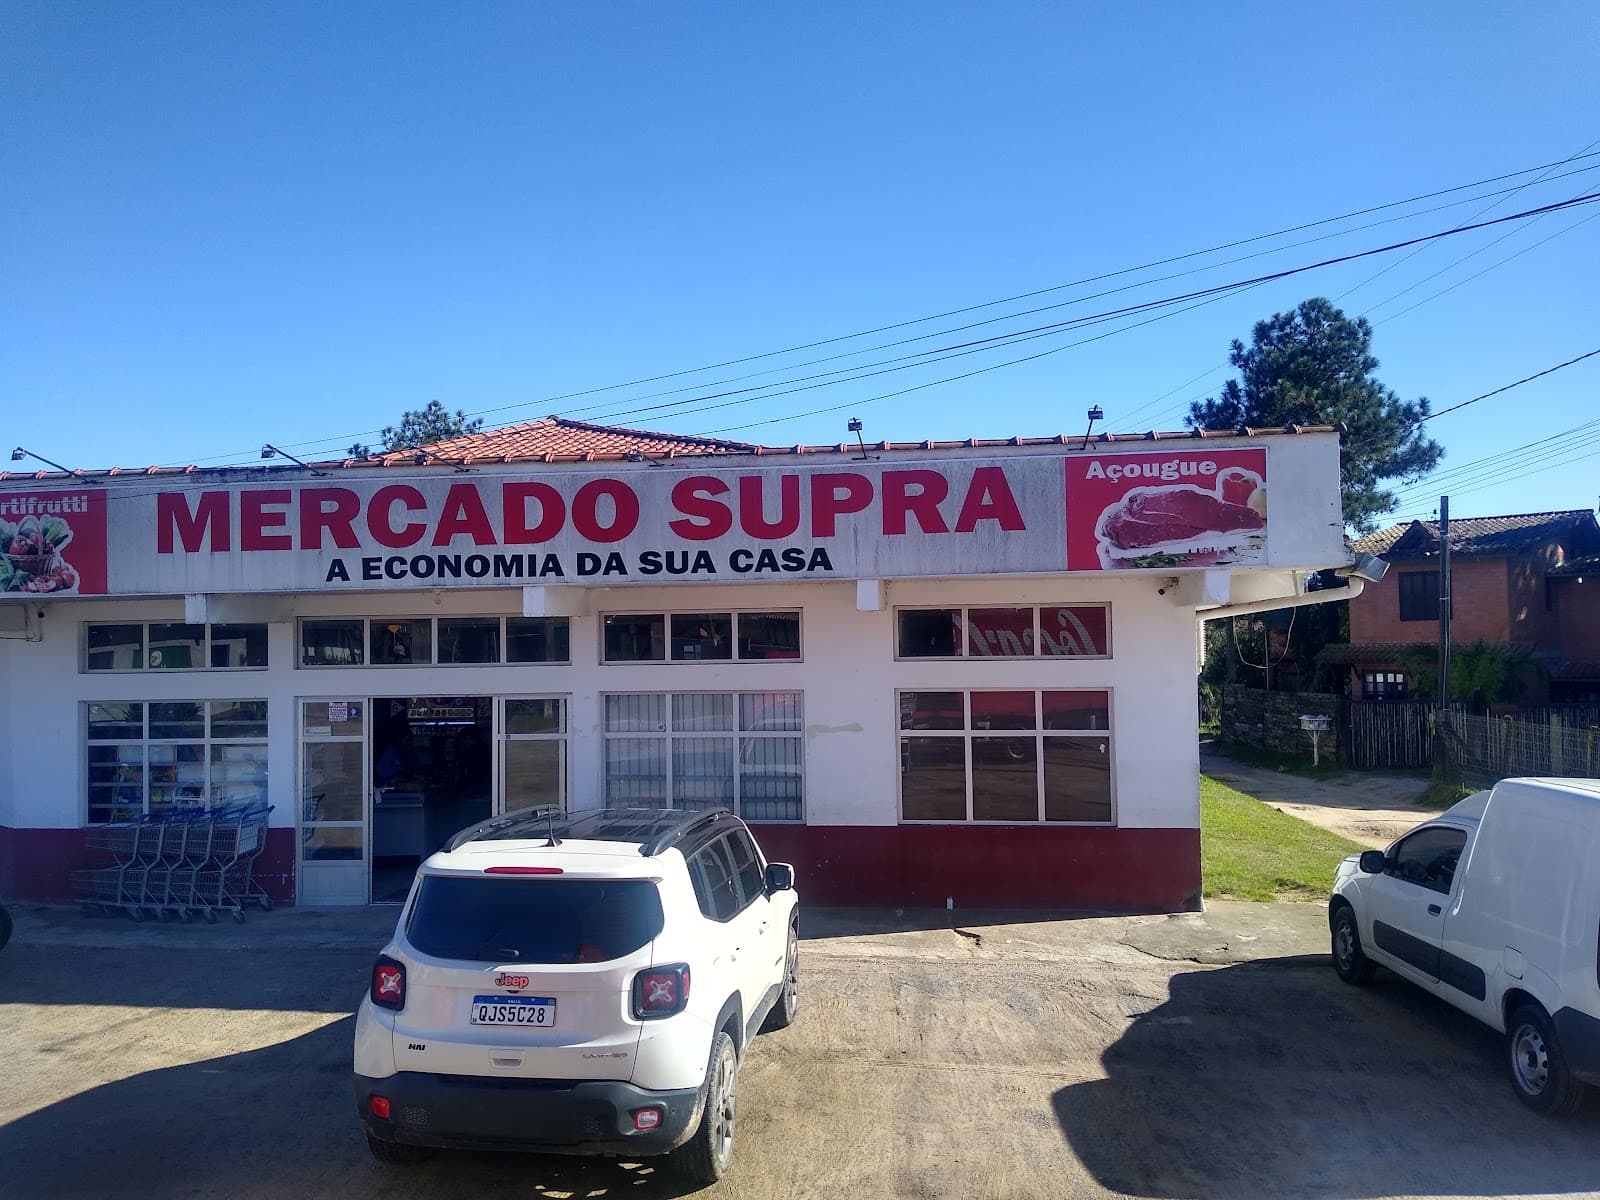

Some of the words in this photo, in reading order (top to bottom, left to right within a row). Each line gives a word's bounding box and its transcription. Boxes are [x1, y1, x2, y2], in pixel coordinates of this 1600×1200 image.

[1085, 459, 1218, 484] Açougue
[156, 480, 639, 554] MERCADO
[668, 467, 1025, 541] SUPRA
[325, 558, 351, 583] A
[361, 552, 566, 582] ECONOMIA
[576, 551, 629, 577] DA
[638, 550, 718, 576] SUA
[729, 547, 835, 574] CASA
[495, 972, 529, 989] Jeep
[478, 1005, 546, 1024] QJS5C28
